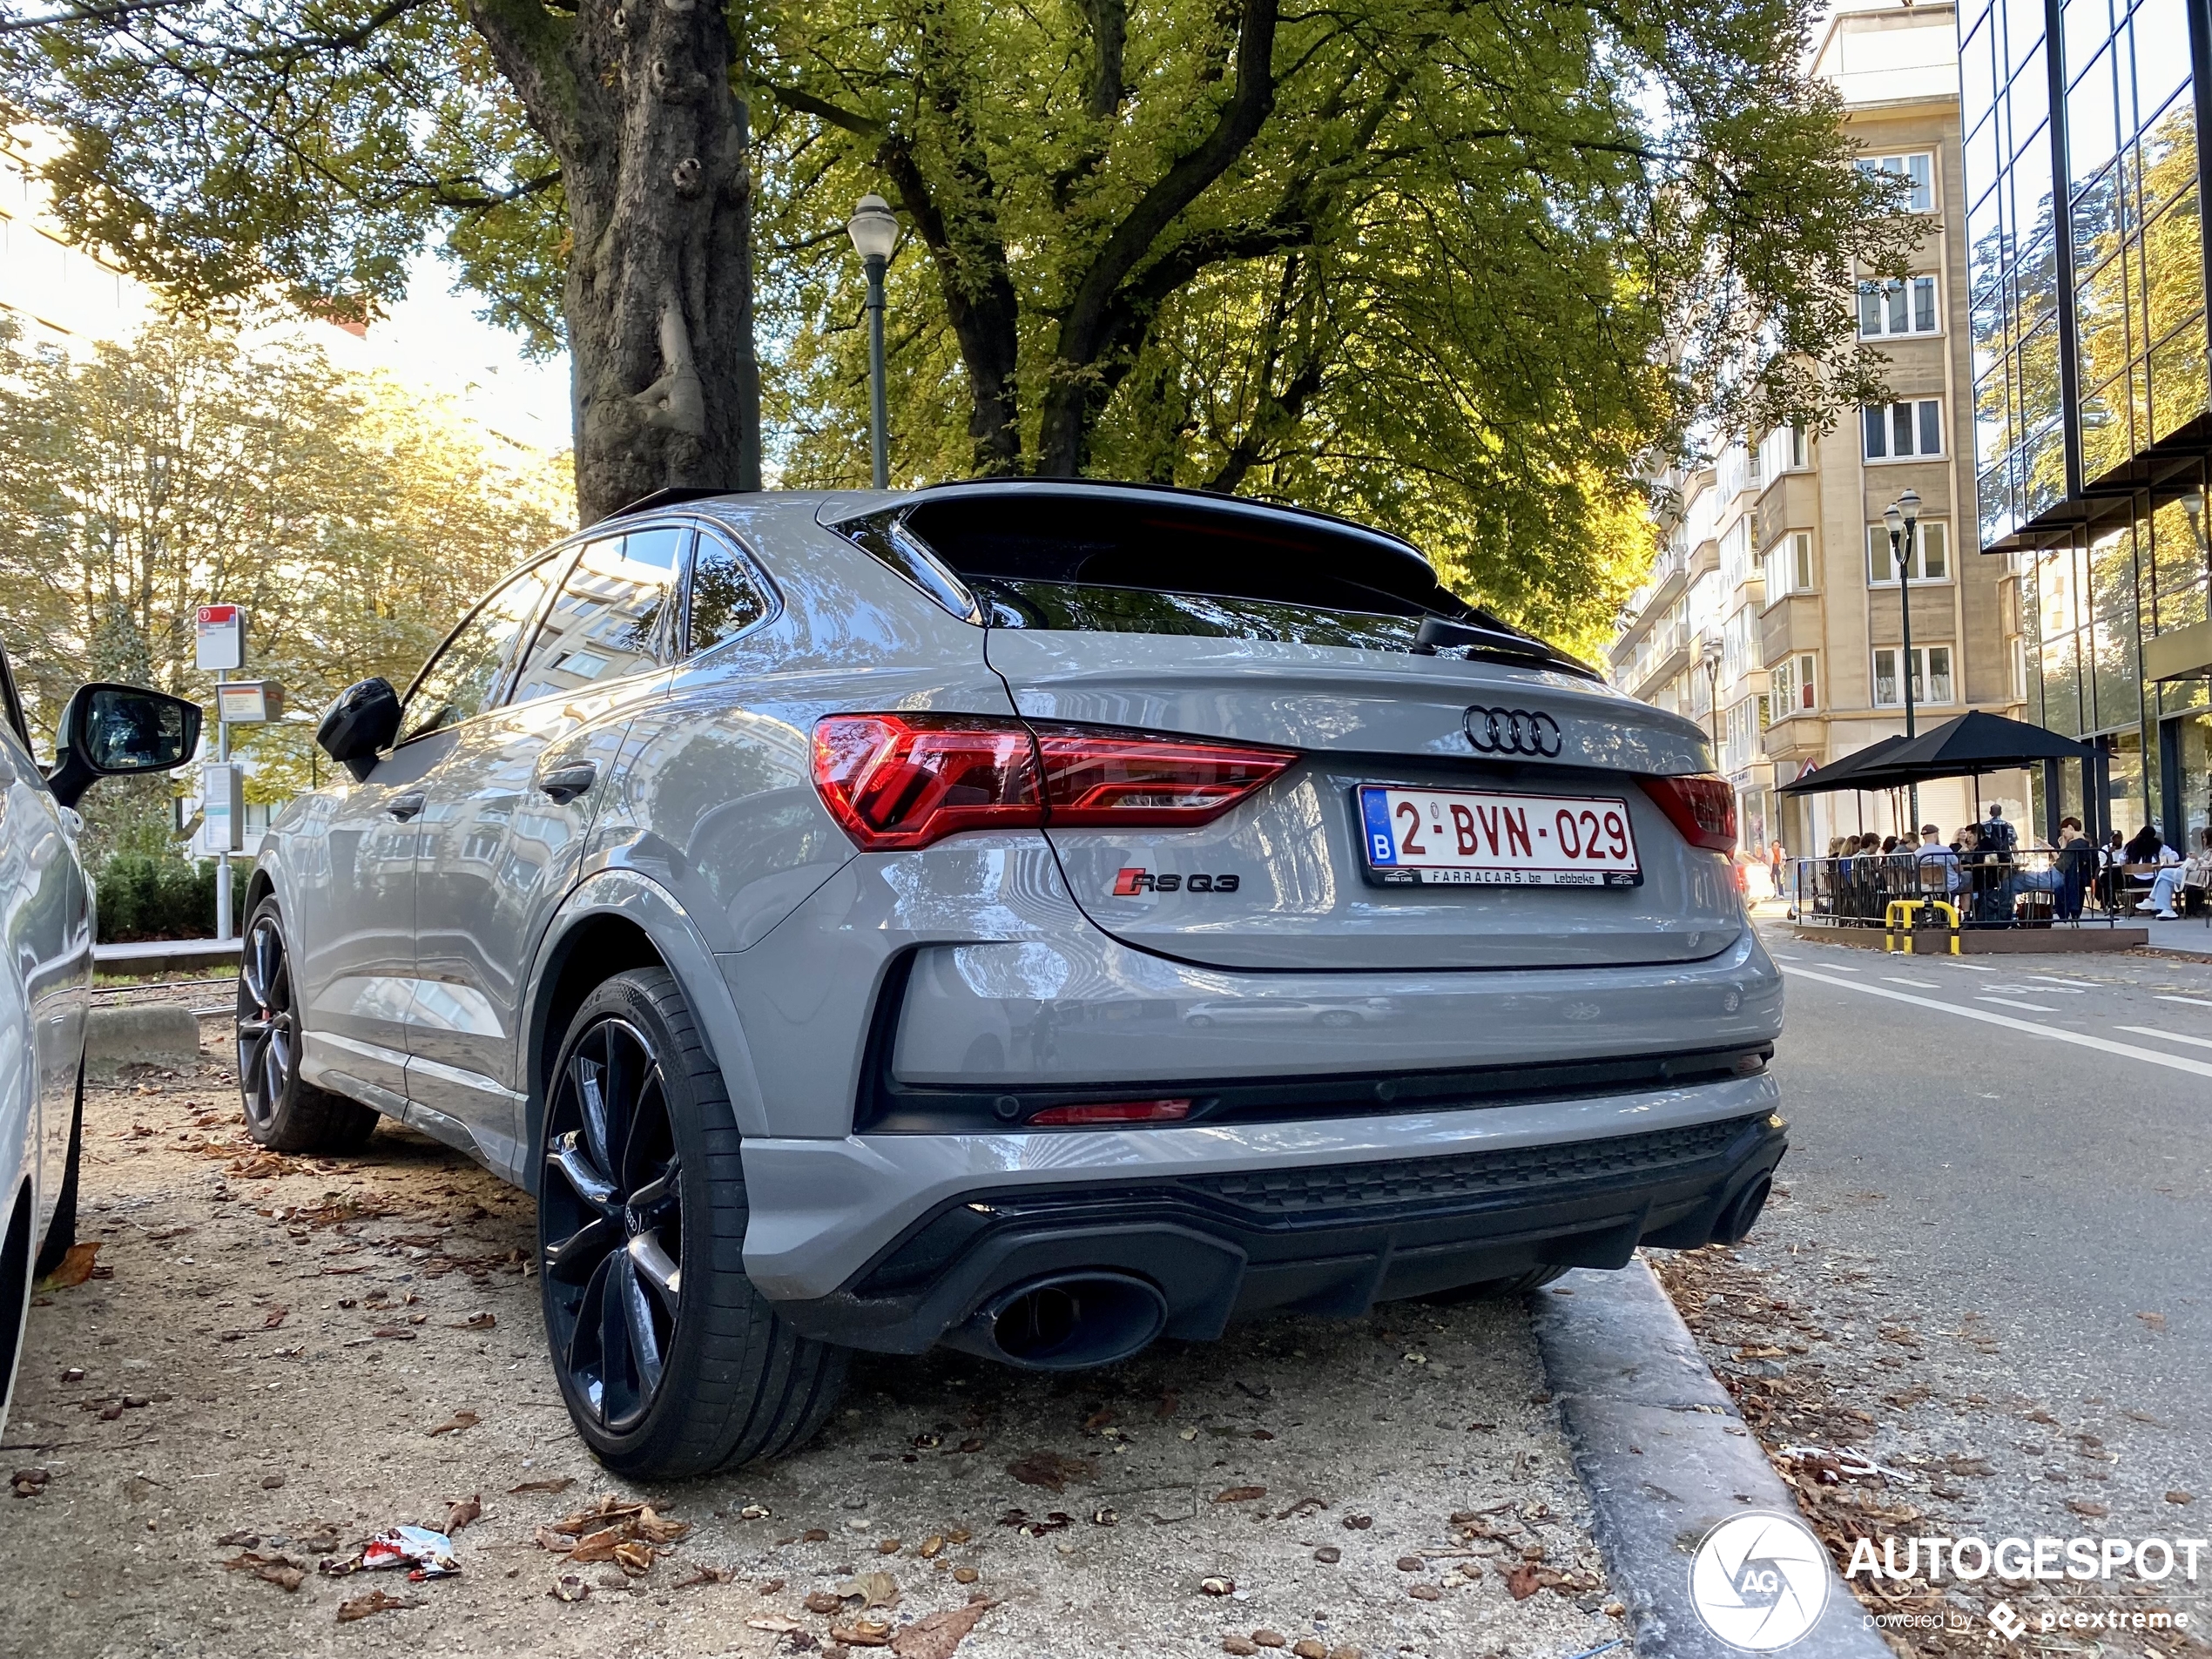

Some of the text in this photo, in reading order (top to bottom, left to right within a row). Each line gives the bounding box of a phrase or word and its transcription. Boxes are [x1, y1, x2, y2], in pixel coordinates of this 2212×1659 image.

[1396, 801, 1628, 860] 2-BVN-029
[1373, 834, 1392, 860] B
[1130, 873, 1240, 893] RS Q3
[1433, 871, 1595, 884] FARRACARS.be Lebbeke
